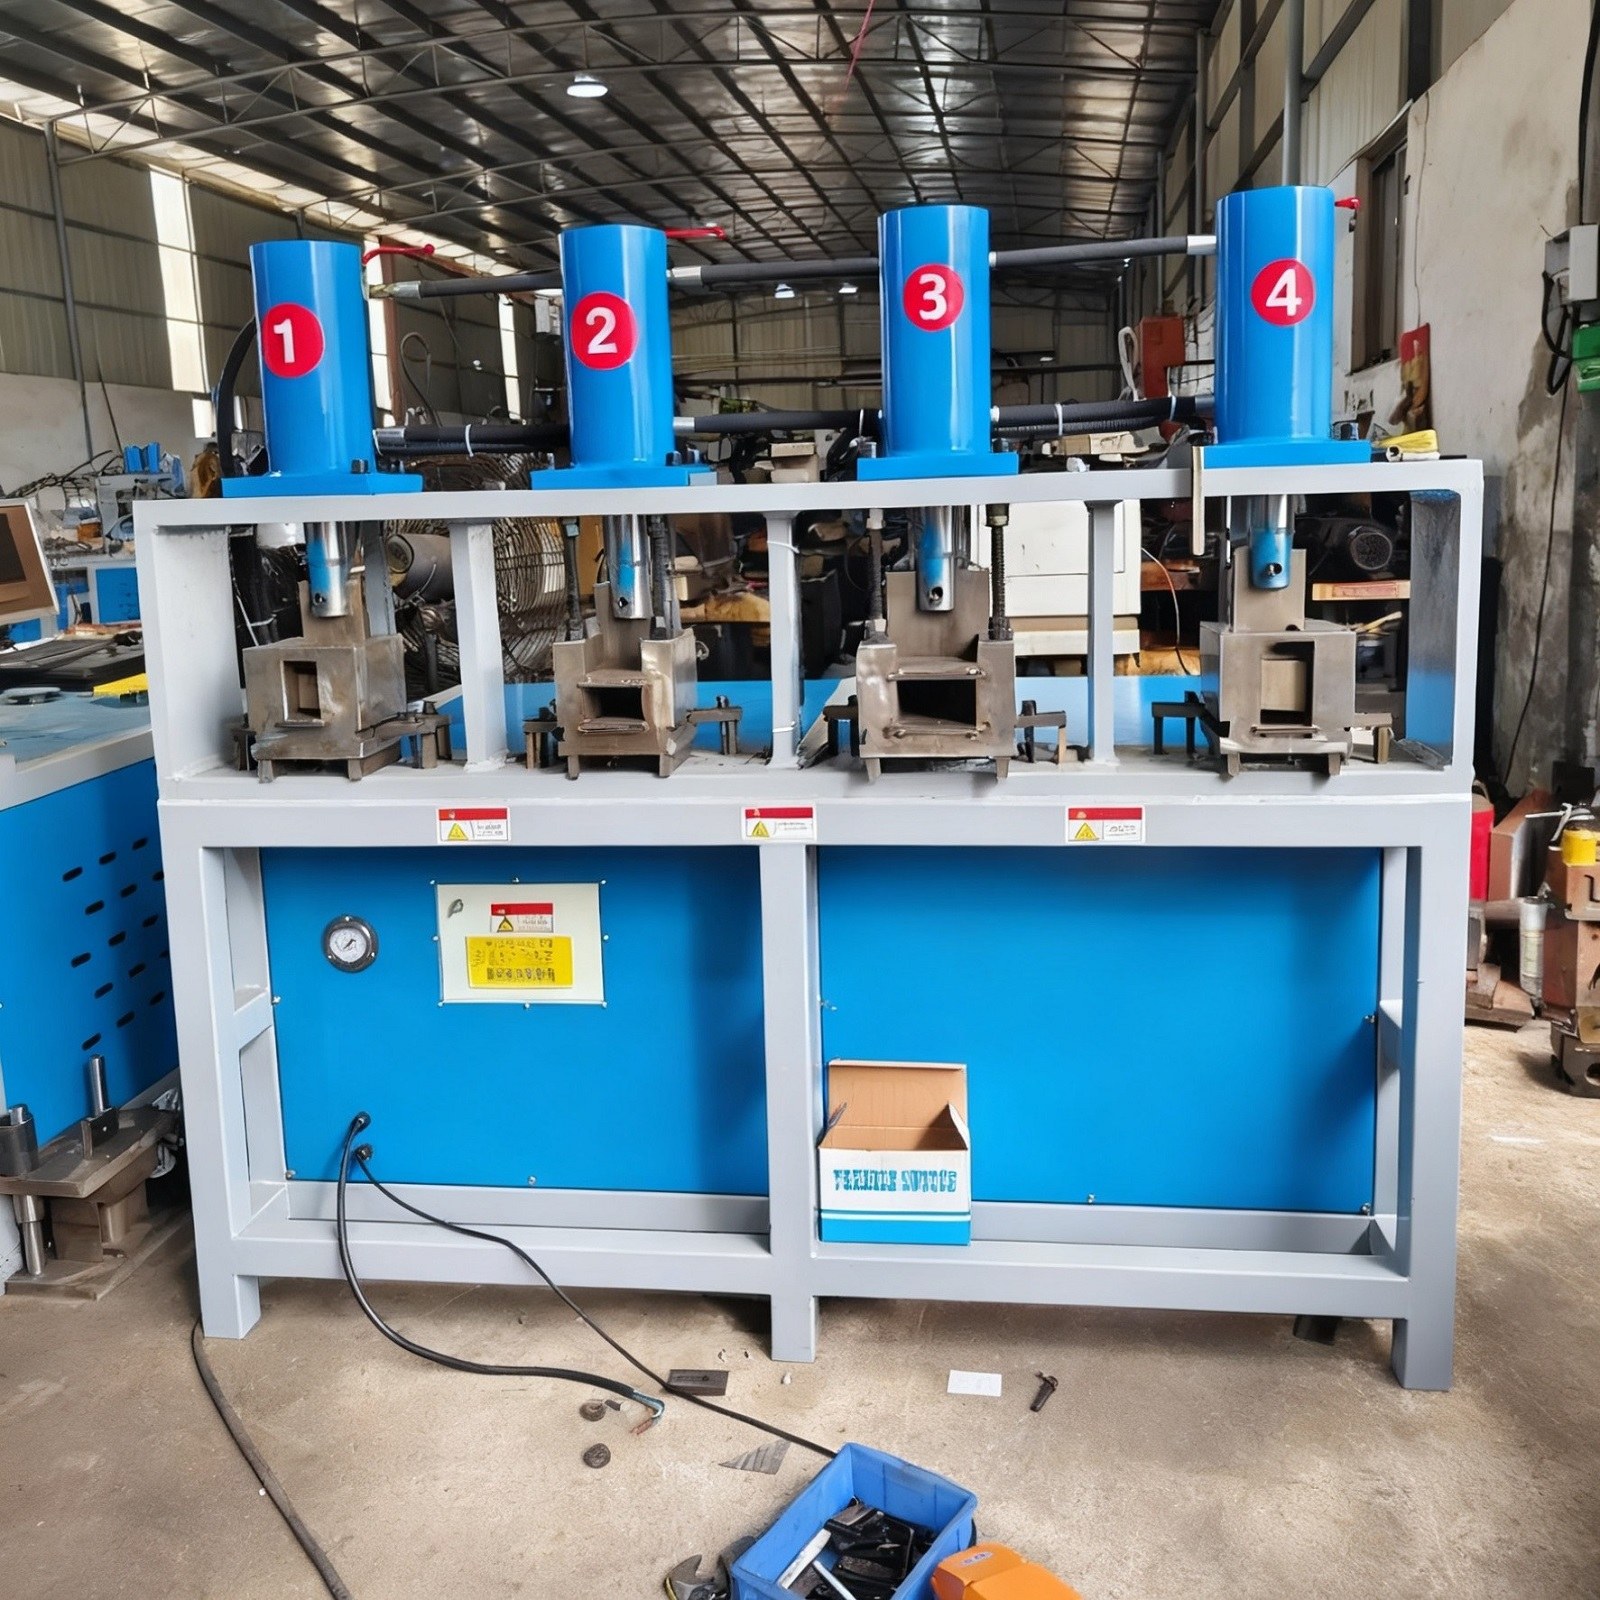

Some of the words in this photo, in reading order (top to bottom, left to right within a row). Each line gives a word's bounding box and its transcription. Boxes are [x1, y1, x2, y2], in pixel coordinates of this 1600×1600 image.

[919, 273, 947, 320] 3
[1265, 268, 1303, 316] 4
[274, 319, 295, 363] 1
[586, 307, 617, 354] 2
